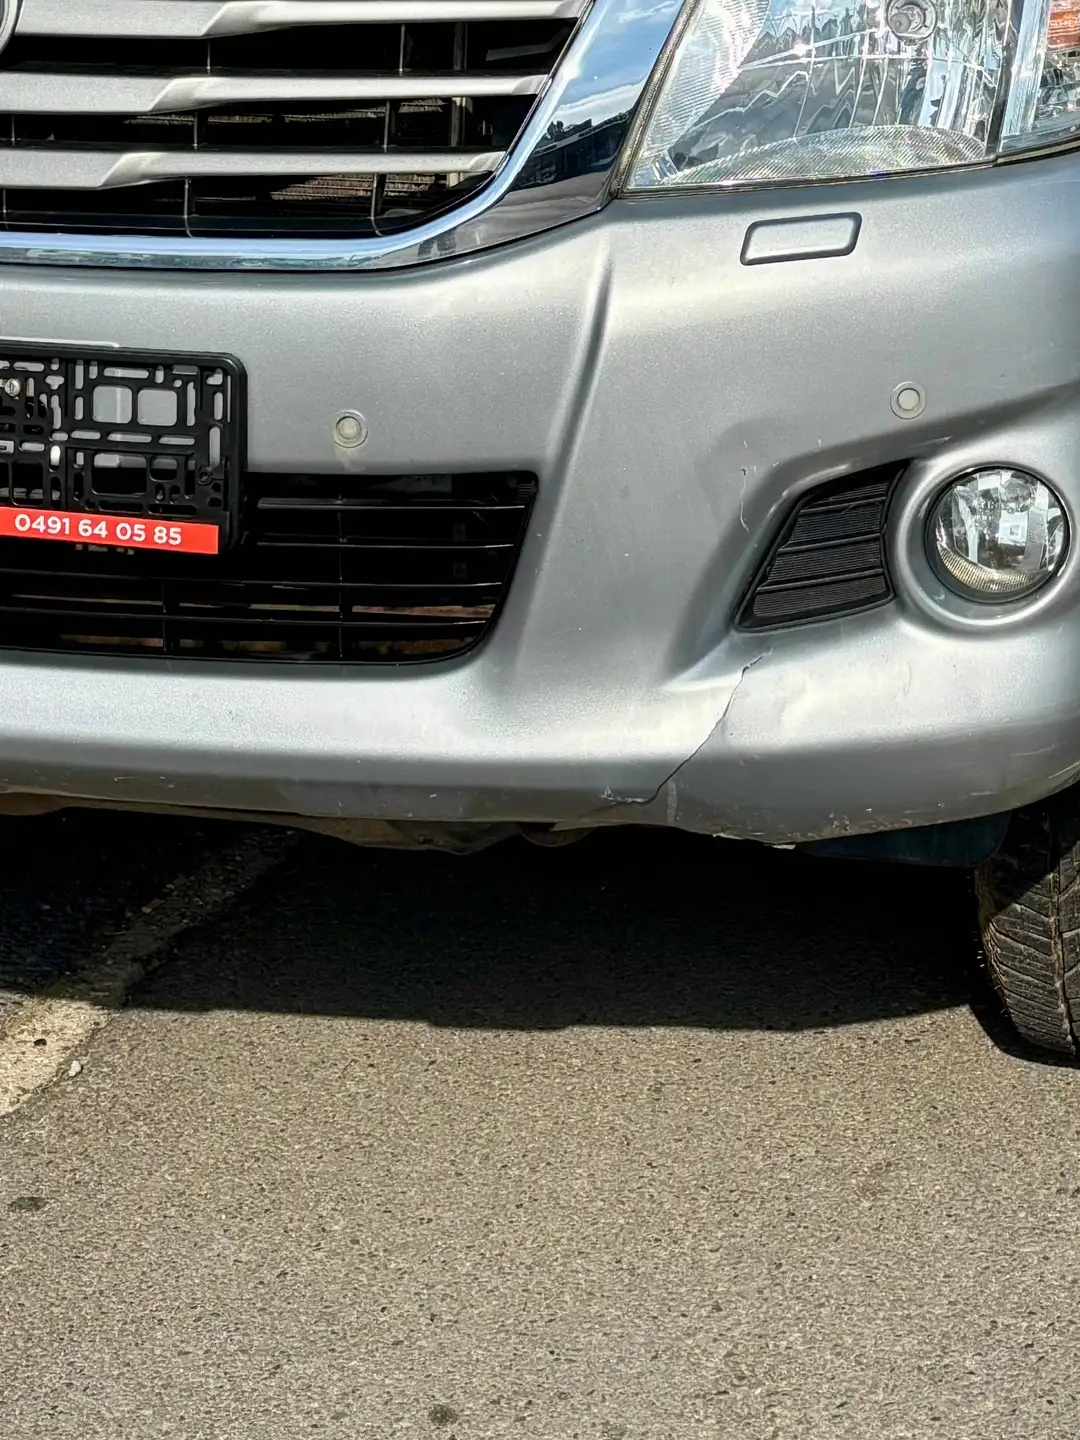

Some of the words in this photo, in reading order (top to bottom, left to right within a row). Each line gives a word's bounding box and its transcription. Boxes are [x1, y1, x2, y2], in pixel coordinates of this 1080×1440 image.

[14, 513, 70, 535] 0491
[78, 519, 108, 538] 64
[116, 522, 146, 542] 05
[153, 525, 182, 545] 85
